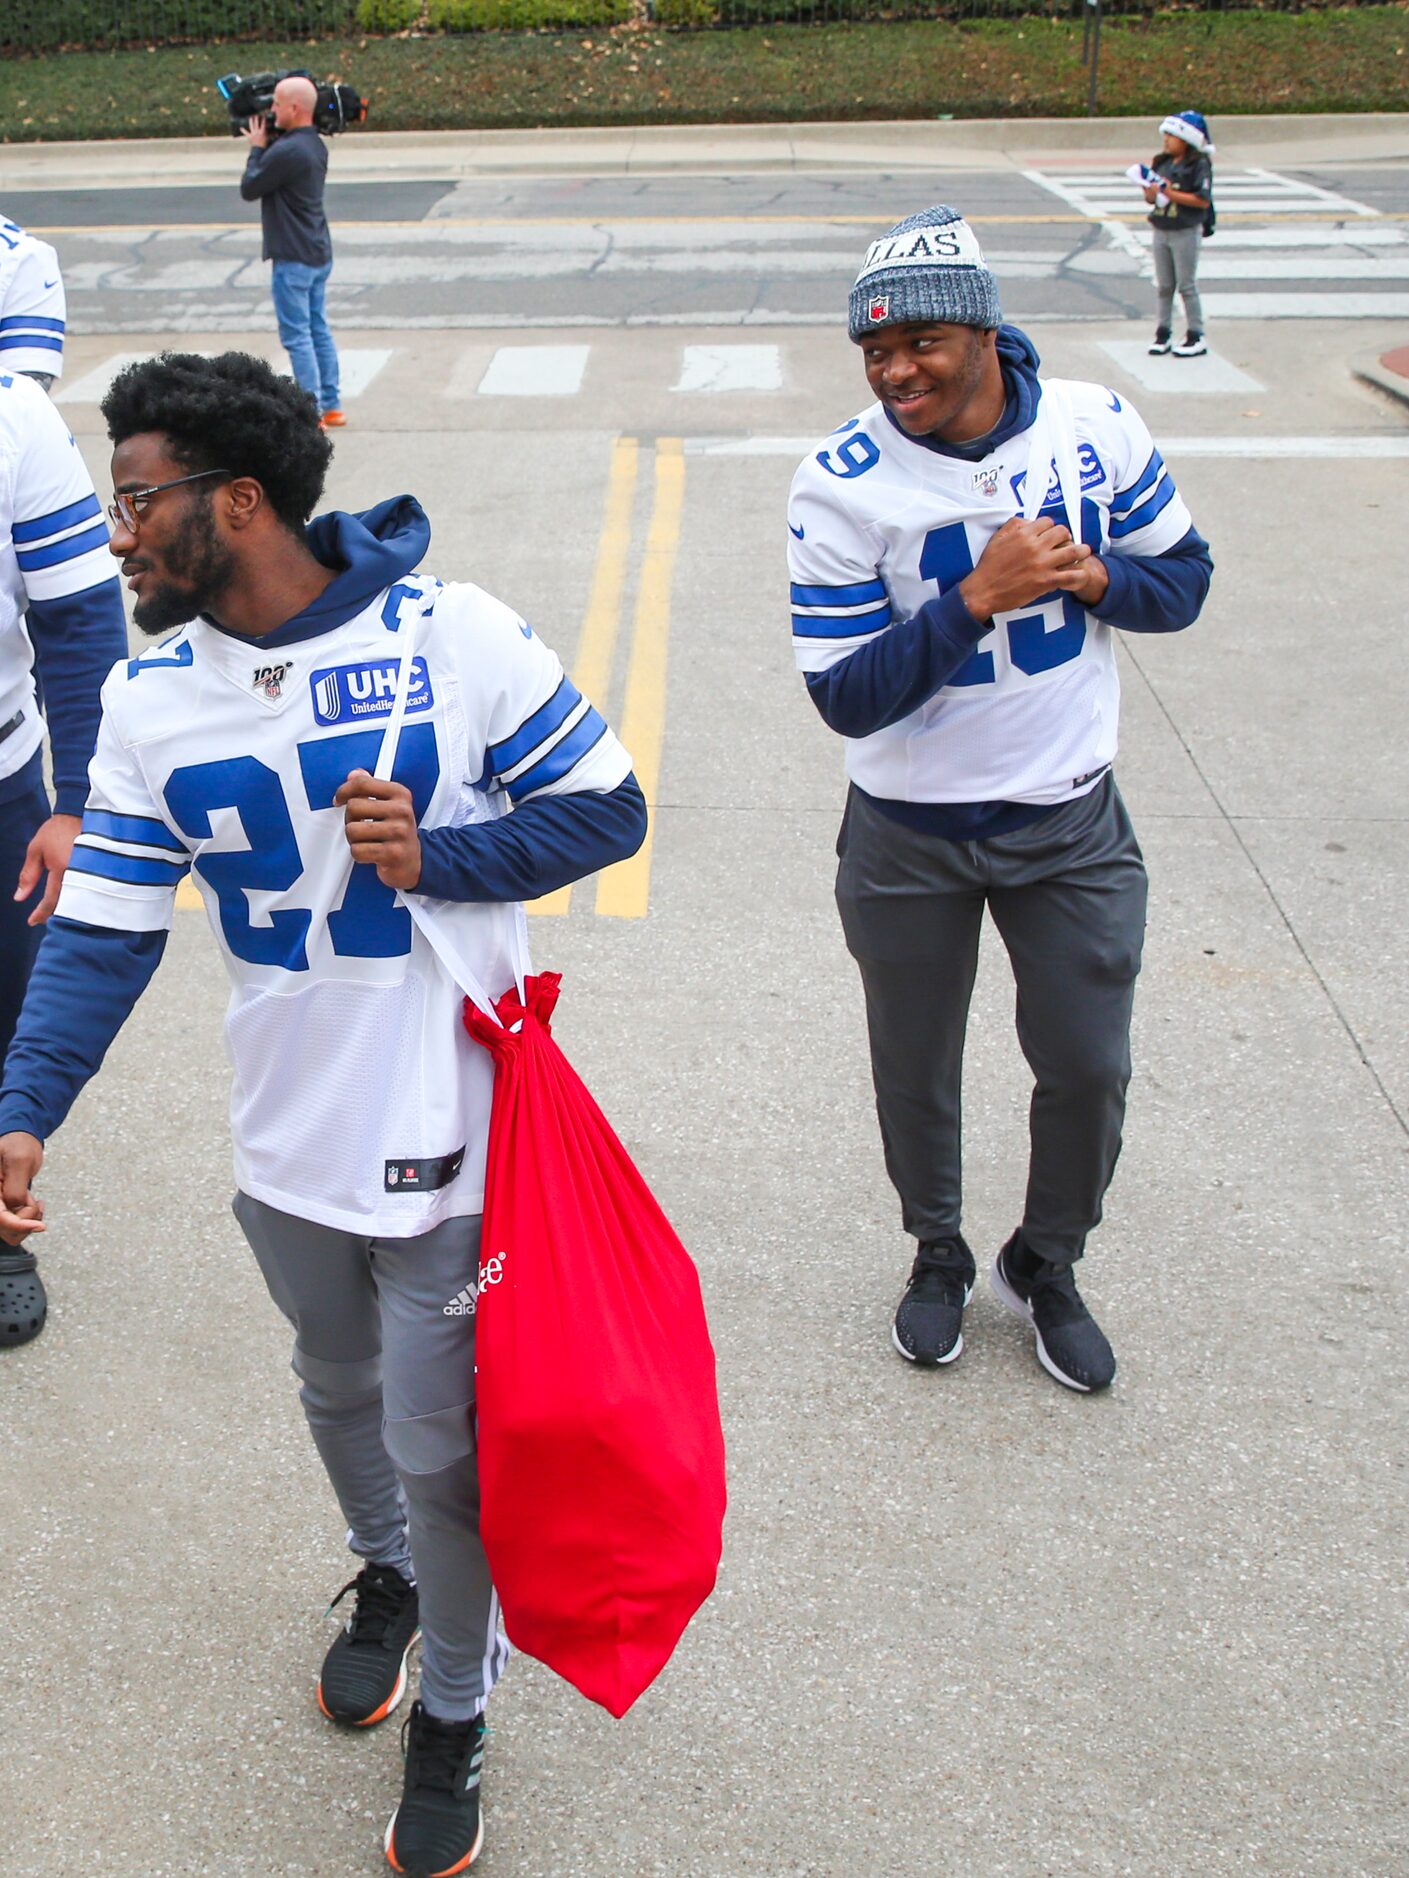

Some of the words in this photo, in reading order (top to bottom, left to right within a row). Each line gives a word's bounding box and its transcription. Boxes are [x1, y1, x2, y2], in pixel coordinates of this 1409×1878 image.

[863, 231, 961, 268] LLAS
[346, 664, 425, 701] UHC
[162, 721, 441, 972] 27
[442, 1302, 478, 1316] adid
